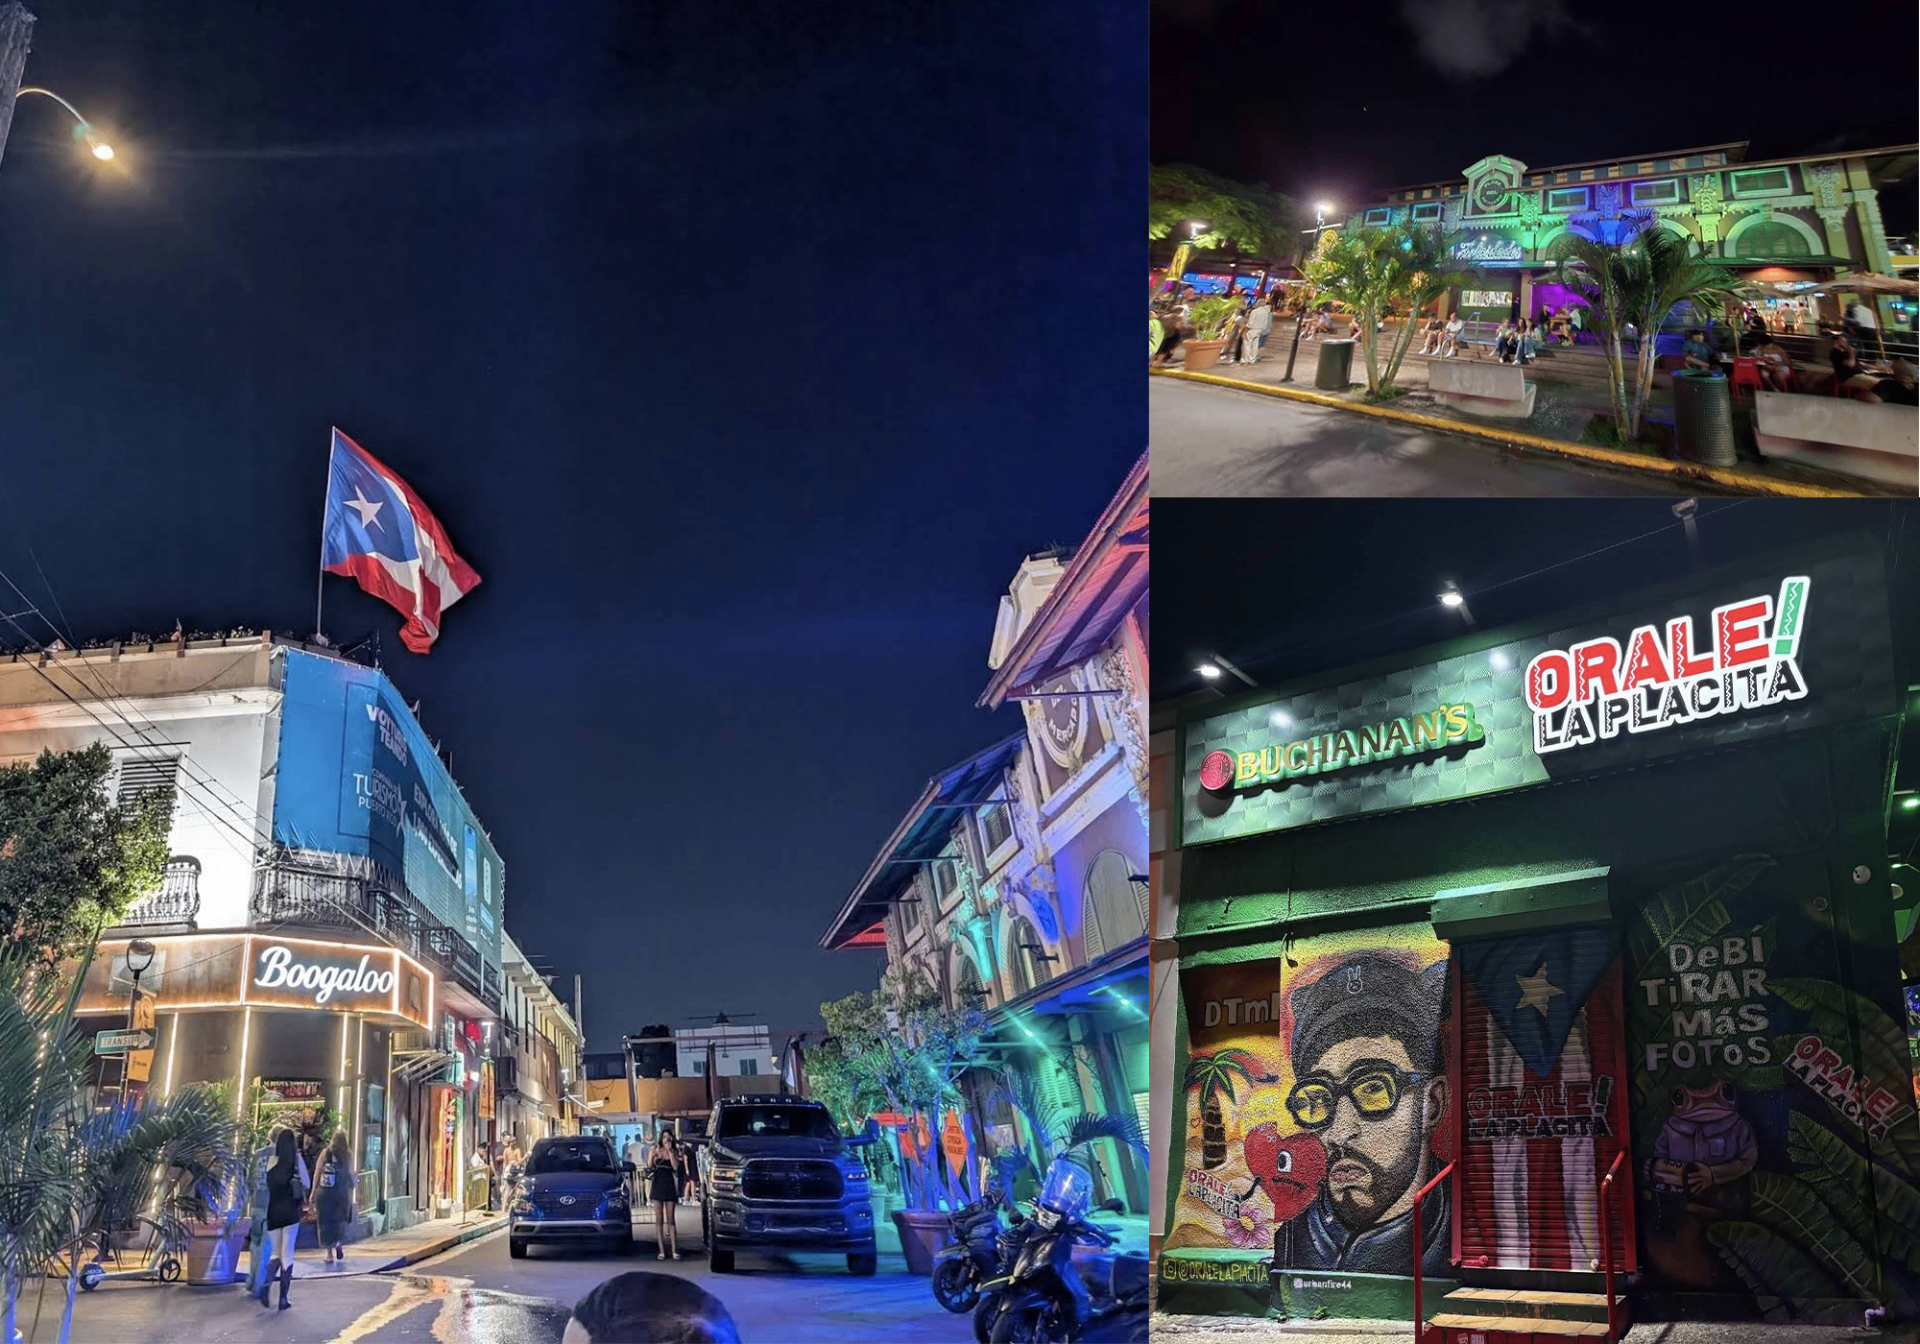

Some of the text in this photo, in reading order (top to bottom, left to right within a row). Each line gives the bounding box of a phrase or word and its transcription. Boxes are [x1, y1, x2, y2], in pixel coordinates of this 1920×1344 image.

[1528, 580, 1806, 710] ORALE!
[1538, 660, 1802, 748] LA PLACITA
[1236, 704, 1472, 781] BUCHANAN'S
[254, 946, 394, 1003] Boogaloo
[1669, 925, 1764, 972] DeBÍ
[1640, 968, 1770, 1006] TiRAR
[1786, 1055, 1810, 1081] LA
[1467, 1074, 1614, 1119] ORALE!
